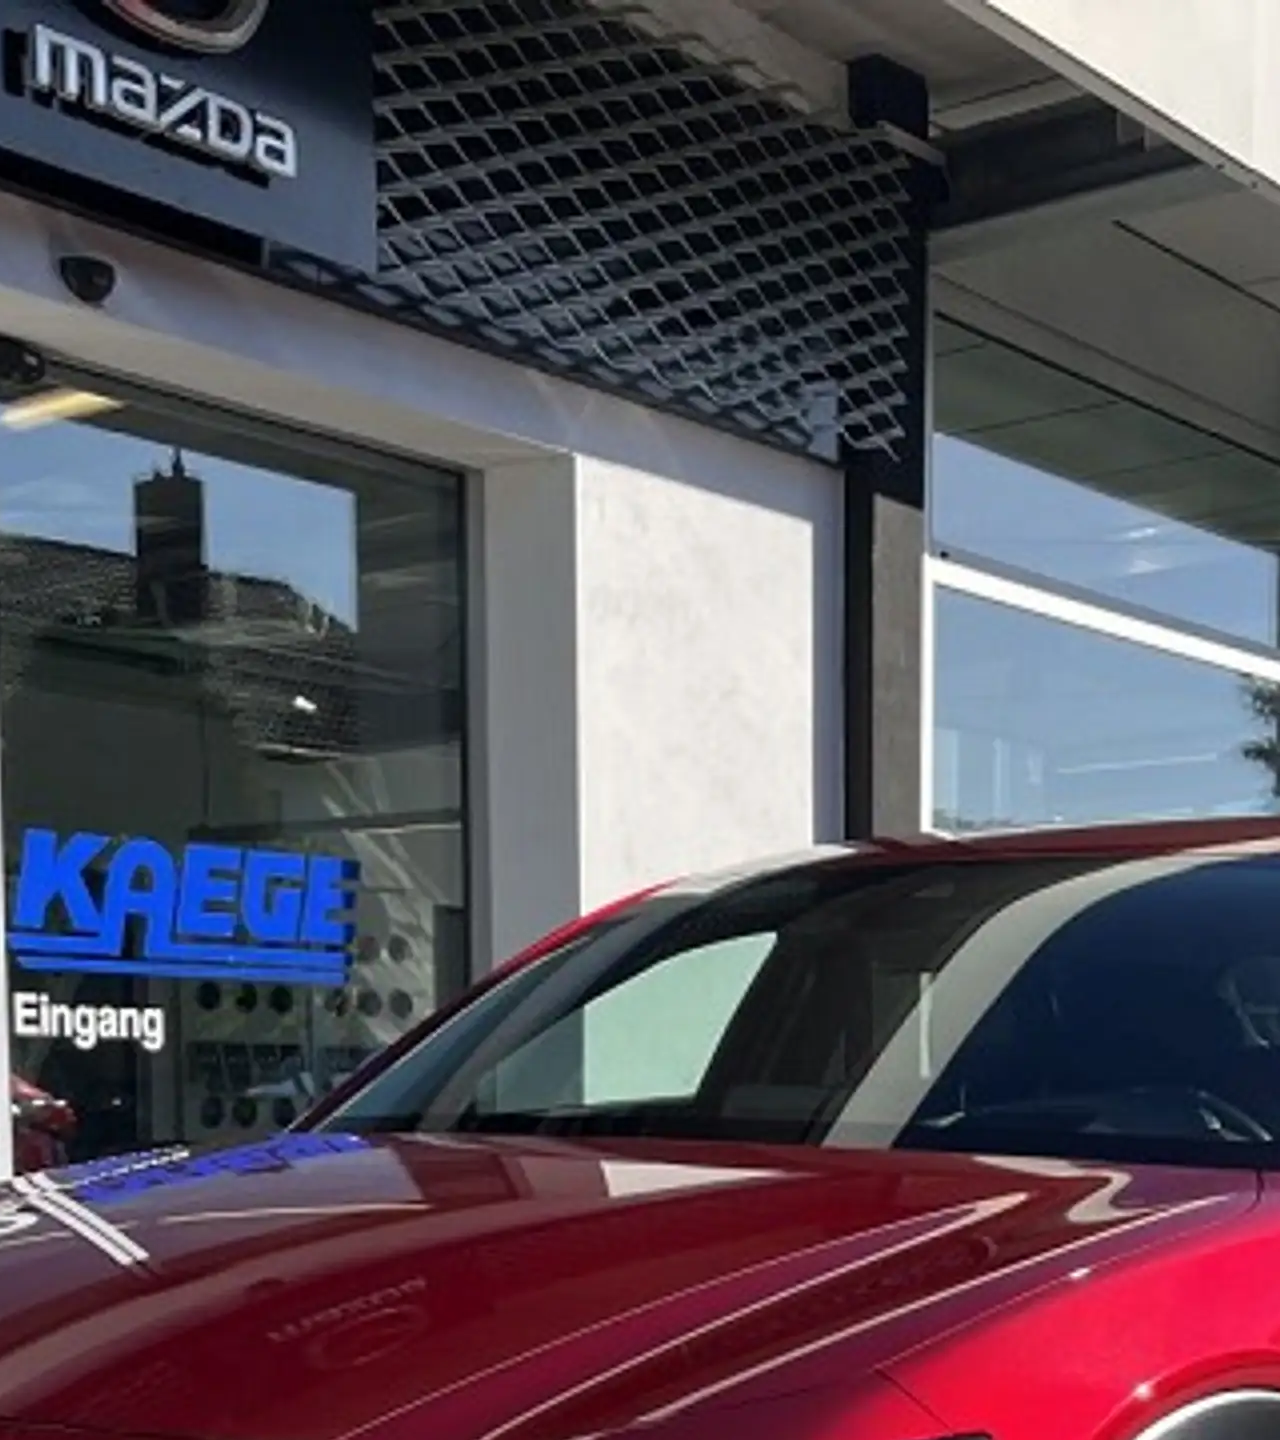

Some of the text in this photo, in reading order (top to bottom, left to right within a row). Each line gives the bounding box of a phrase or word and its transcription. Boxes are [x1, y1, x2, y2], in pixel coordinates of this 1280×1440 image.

[32, 24, 297, 177] mazda
[12, 829, 356, 955] KAEGE
[14, 992, 165, 1050] Eingang
